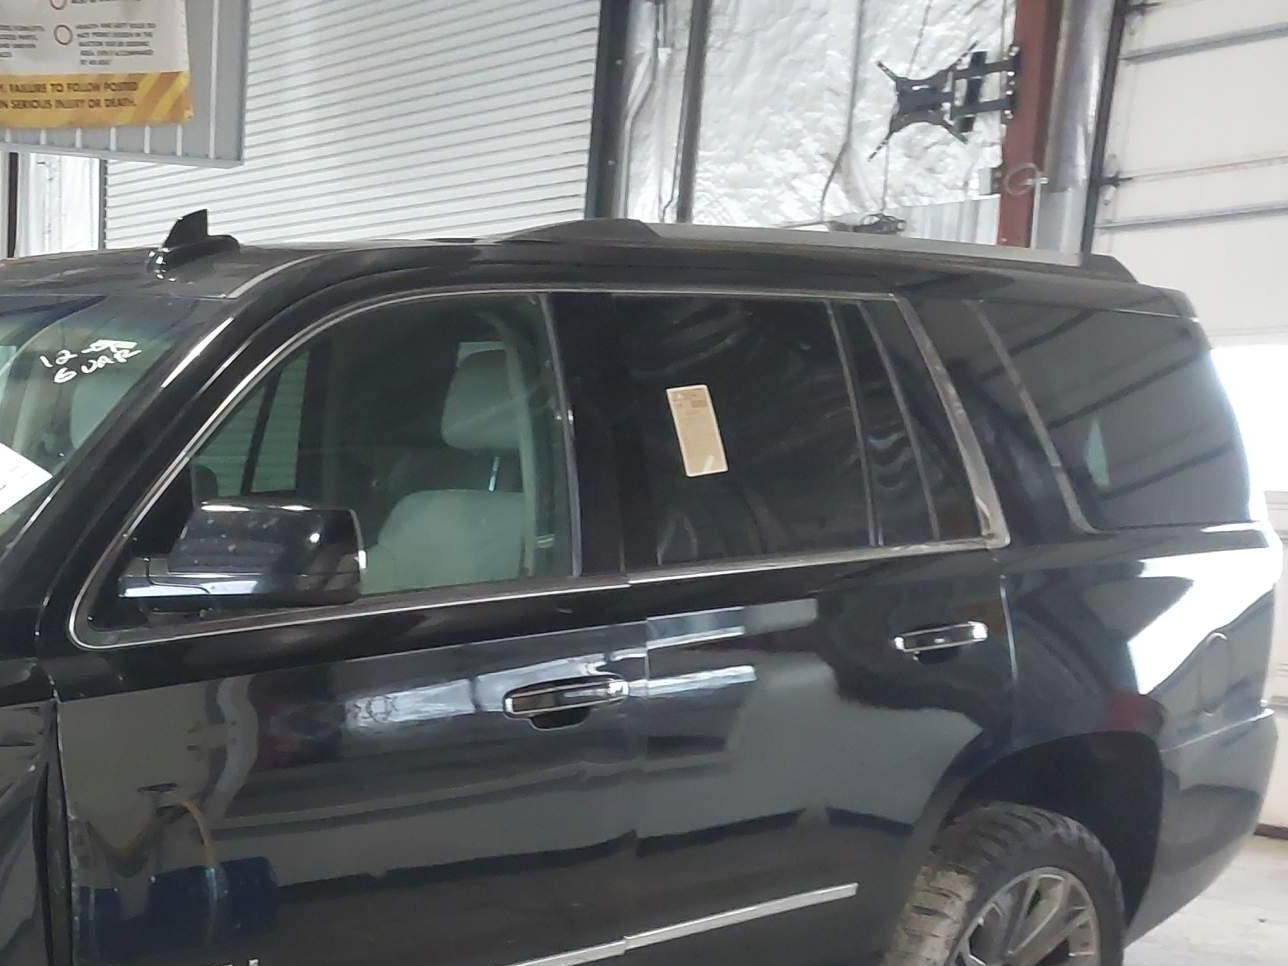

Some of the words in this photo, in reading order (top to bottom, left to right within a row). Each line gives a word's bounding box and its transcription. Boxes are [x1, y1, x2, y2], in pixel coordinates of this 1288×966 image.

[50, 82, 64, 92] TO
[67, 82, 101, 92] FOLLOW
[11, 99, 52, 109] SERIOUS
[88, 98, 101, 108] OR
